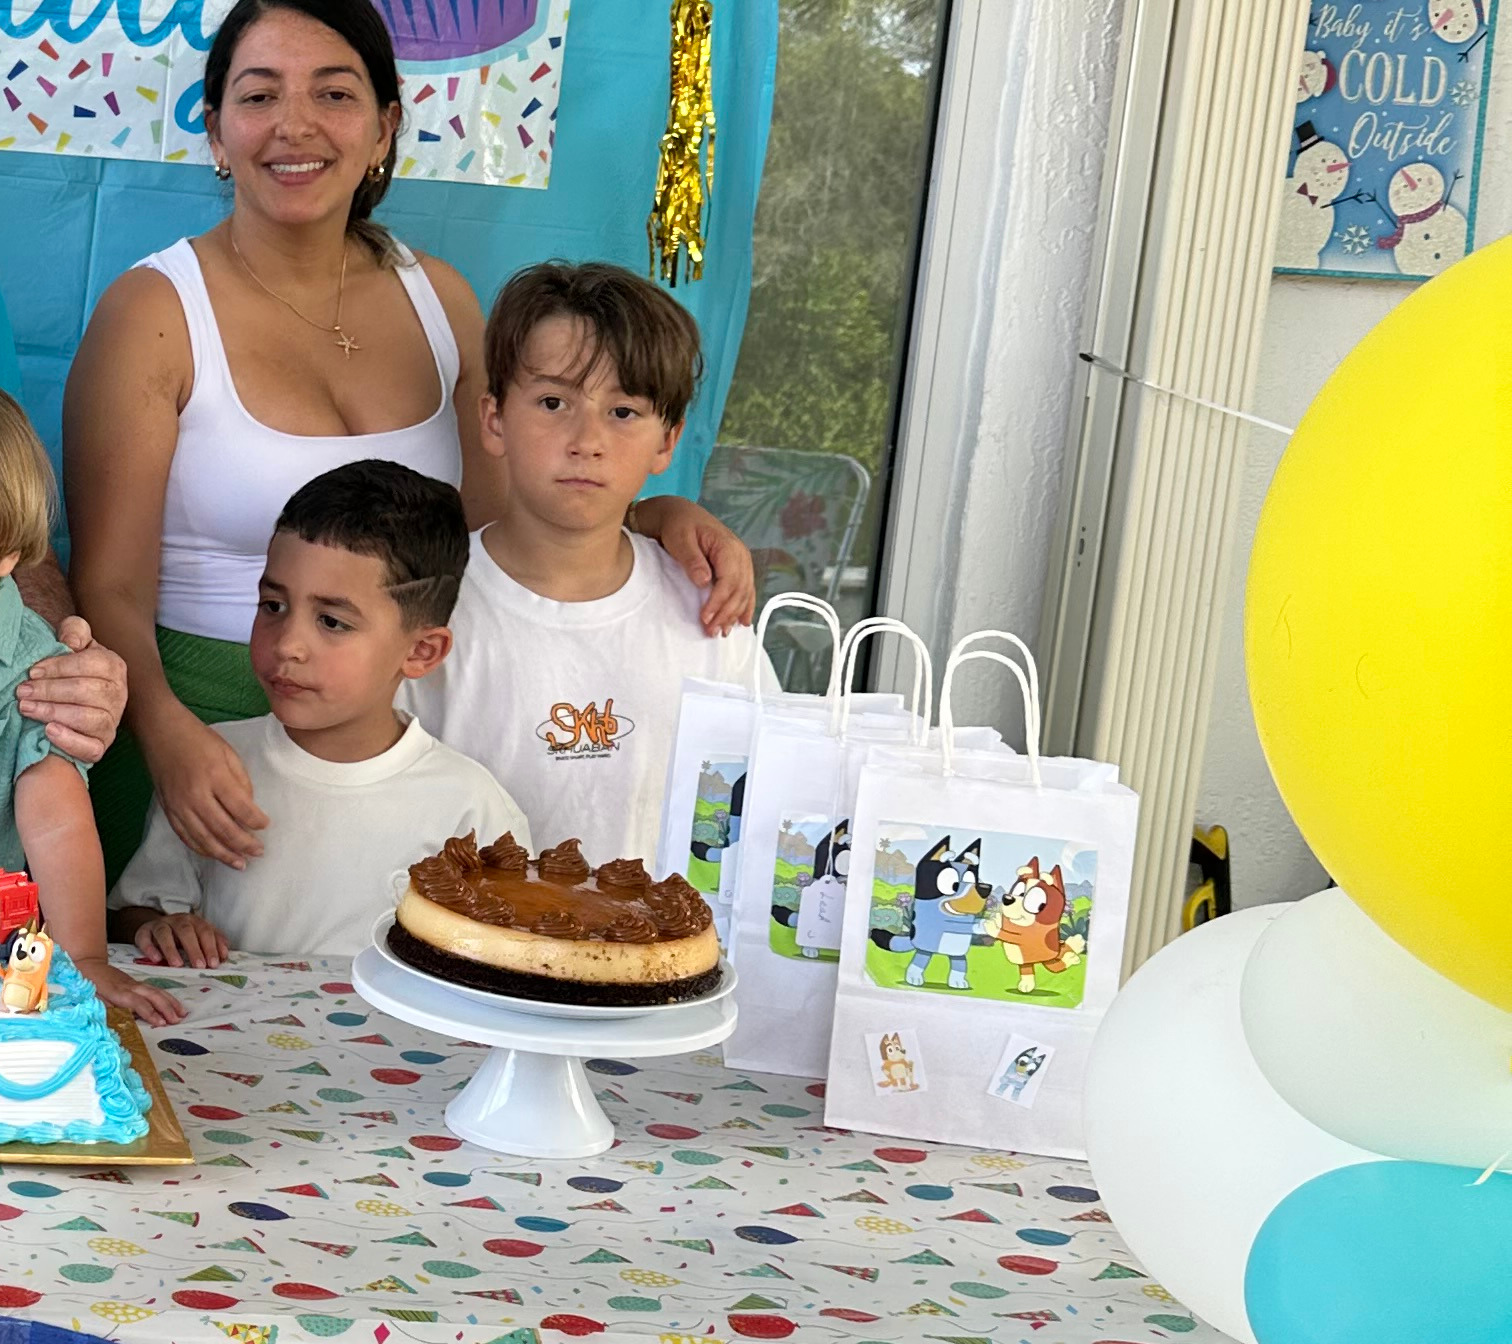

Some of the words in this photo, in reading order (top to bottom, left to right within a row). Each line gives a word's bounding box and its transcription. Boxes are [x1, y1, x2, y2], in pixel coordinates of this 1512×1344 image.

[1315, 3, 1372, 49] Baby
[1384, 6, 1430, 43] it's
[1339, 49, 1448, 105] COLD
[1348, 111, 1457, 161] Outside
